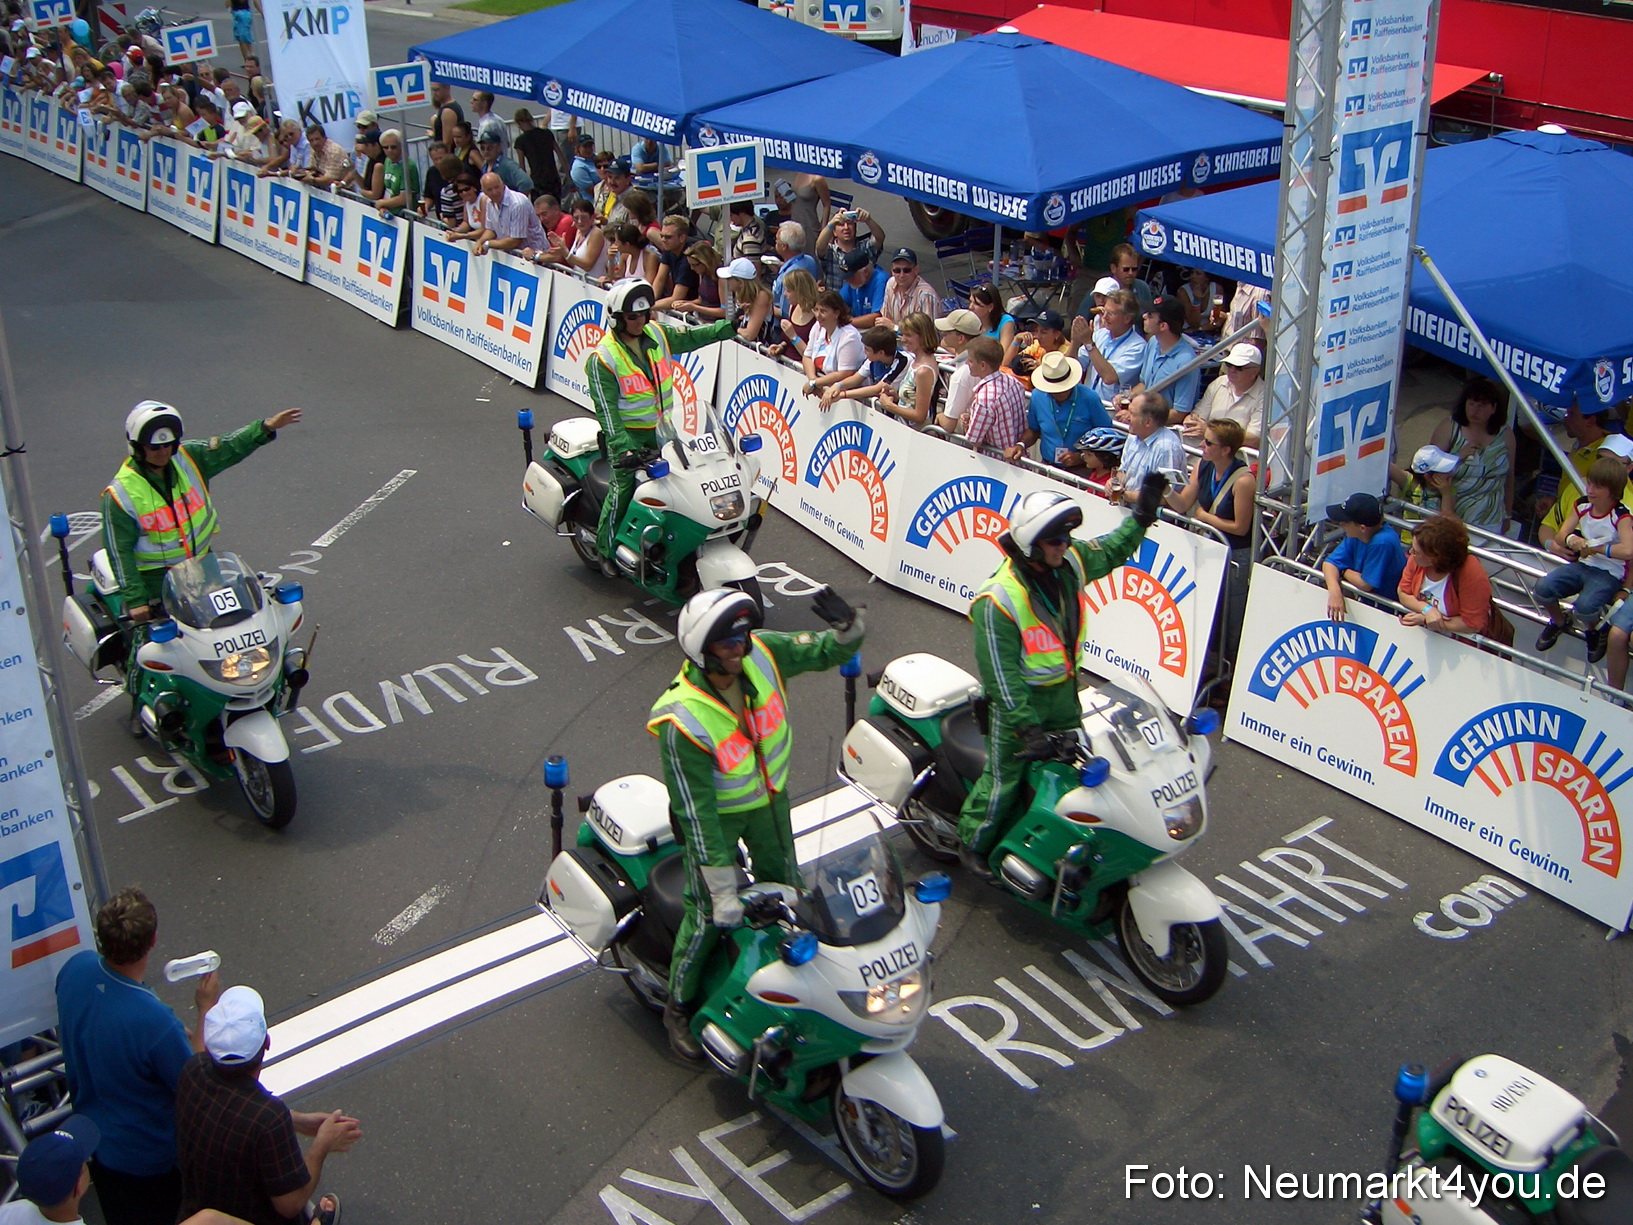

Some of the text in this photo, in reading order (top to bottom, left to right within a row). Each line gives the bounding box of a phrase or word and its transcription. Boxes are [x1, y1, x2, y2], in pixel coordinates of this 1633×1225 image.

[283, 5, 350, 40] KMP
[1374, 24, 1423, 37] Raiffeisenbanken
[1375, 15, 1414, 26] Volksbanken
[1370, 61, 1420, 75] Raiffeisenbanken
[1371, 52, 1409, 64] Volksbanken
[434, 60, 532, 93] SCHNEIDER WEISSE
[566, 88, 677, 137] SCHNEIDER WEISSE
[1367, 97, 1416, 113] Raiffeisenbanken
[1368, 89, 1405, 101] Volksbanken
[794, 142, 844, 170] WEISSE
[1214, 147, 1269, 175] SCHNEIDER
[888, 163, 1029, 221] SCHNEIDER WEISSE
[1070, 161, 1182, 213] SCHNEIDER WEISSE
[1359, 216, 1394, 231] Volksbanken
[1359, 223, 1405, 242] Raiffeisenbanken
[223, 225, 301, 269] Volksbanken Raiffeisenbanken
[1173, 229, 1257, 274] SCHNEIDER
[1357, 251, 1391, 267] Volksbanken
[1356, 257, 1402, 277] Raiffeisenbanken
[342, 276, 394, 313] Raiffeisenbanken
[1352, 292, 1400, 312] Raiffeisenbanken
[1354, 286, 1390, 301] Volksbanken
[417, 305, 532, 373] Volksbanken Raiffeisenbanken
[557, 304, 596, 350] GEWINN
[1348, 326, 1397, 347] Raiffeisenbanken
[1349, 320, 1388, 336] Volksbanken
[1346, 354, 1385, 370] Volksbanken
[1346, 359, 1394, 381] Raiffeisenbanken
[551, 369, 581, 391] Immer ein
[726, 379, 770, 428] GEWINN
[550, 431, 570, 453] POLIZEI
[699, 436, 716, 453] 06
[761, 406, 796, 477] SPAREN
[811, 425, 862, 478] GEWINN
[700, 473, 742, 496] POLIZEI
[851, 455, 886, 534] SPAREN
[800, 497, 866, 551] Immer ein Gewinn.
[915, 481, 992, 537] GEWINN
[899, 559, 937, 584] Immer
[938, 577, 957, 593] ein
[213, 590, 238, 611] 05
[1125, 573, 1182, 667] SPAREN
[213, 629, 267, 658] POLIZEI
[1083, 639, 1153, 682] ein Gewinn.
[1259, 626, 1357, 688] GEWINN
[882, 674, 917, 712] POLIZEI
[1338, 664, 1412, 767] SPAREN
[1142, 721, 1164, 746] 07
[1240, 711, 1376, 786] Immer ein Gewinn.
[1449, 708, 1561, 772] GEWINN
[1151, 769, 1199, 808] POLIZEI
[590, 798, 623, 846] POLIZEI
[1536, 752, 1614, 866] SPAREN
[1424, 796, 1574, 884] Immer ein Gewinn.
[851, 879, 880, 911] 03
[1412, 874, 1528, 940] com
[858, 941, 921, 988] POLIZEI
[1443, 1094, 1514, 1160] POLIZEI
